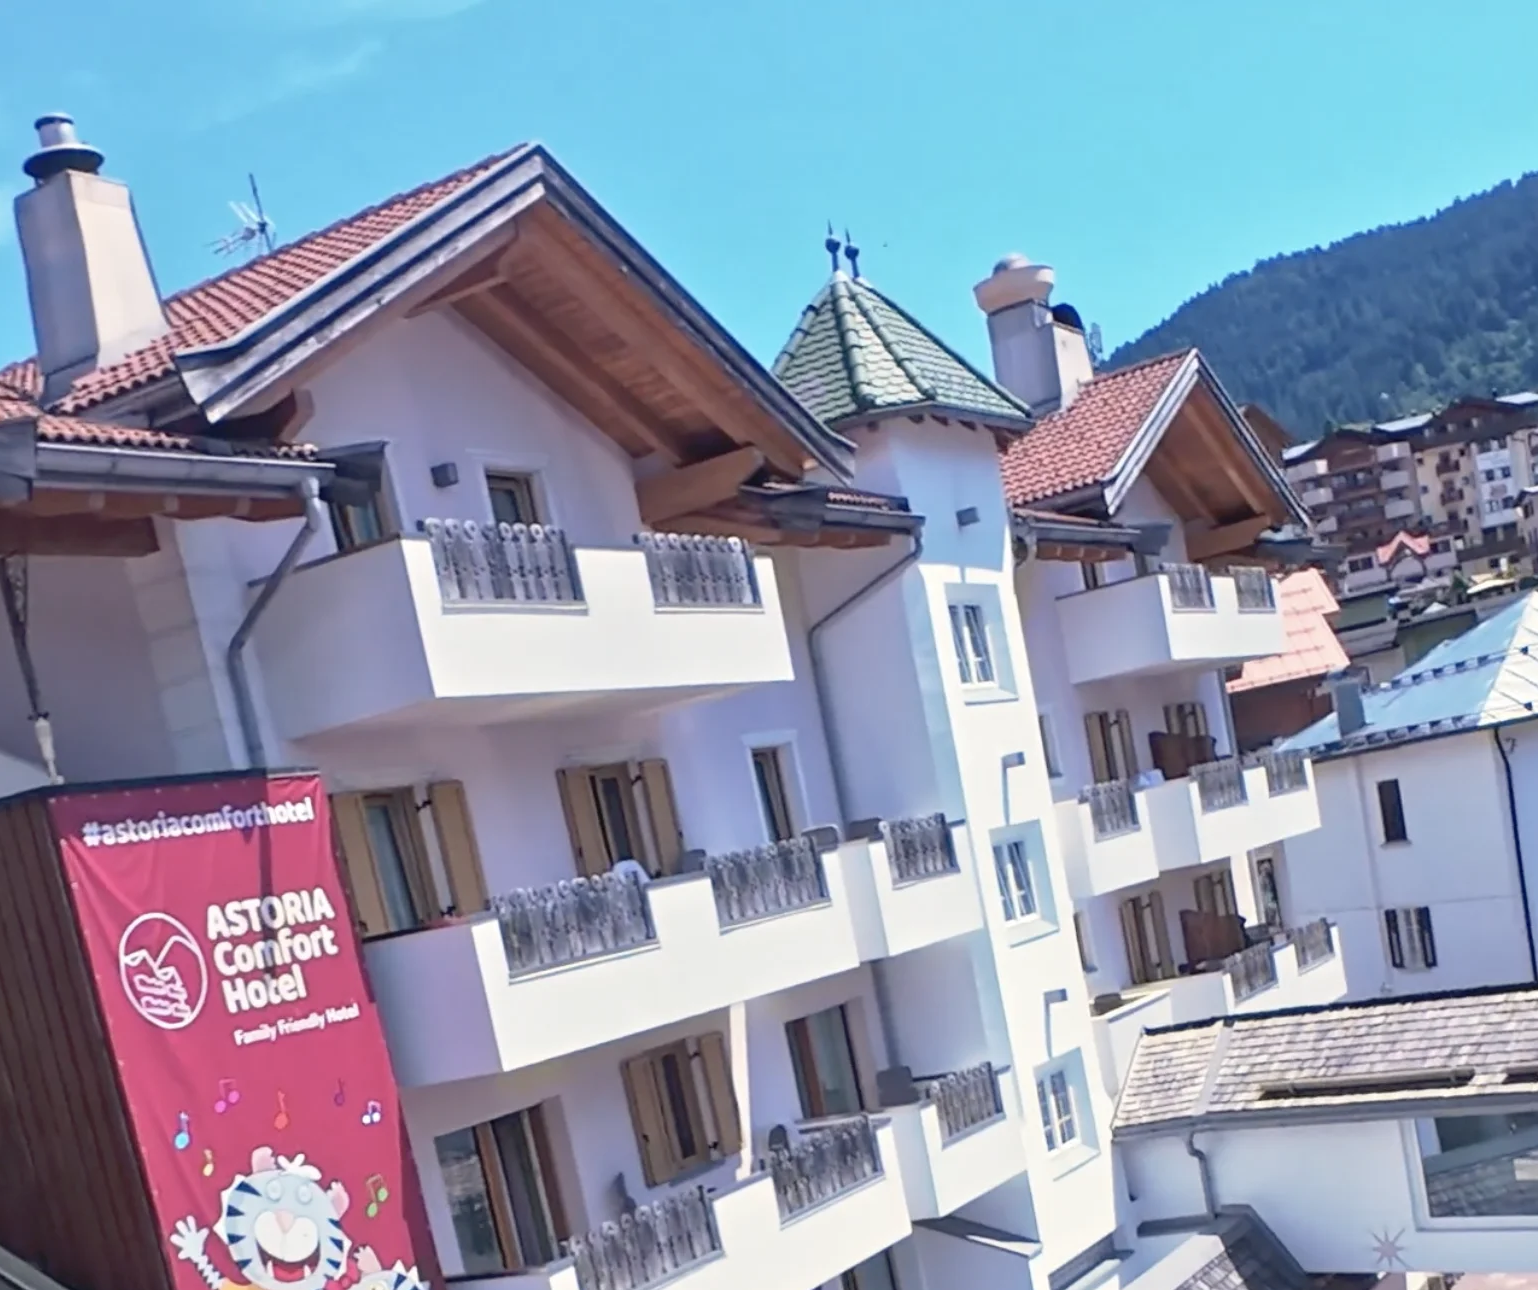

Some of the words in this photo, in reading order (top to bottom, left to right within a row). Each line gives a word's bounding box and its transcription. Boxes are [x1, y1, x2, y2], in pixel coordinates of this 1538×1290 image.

[82, 797, 315, 847] #astoriacomforthotel
[207, 887, 335, 940] ASTORIA
[213, 925, 339, 976] Comfort
[222, 963, 307, 1013] Hotel
[233, 1023, 277, 1046] Family
[277, 1012, 325, 1035] Friendly
[325, 1002, 360, 1023] Hotel
